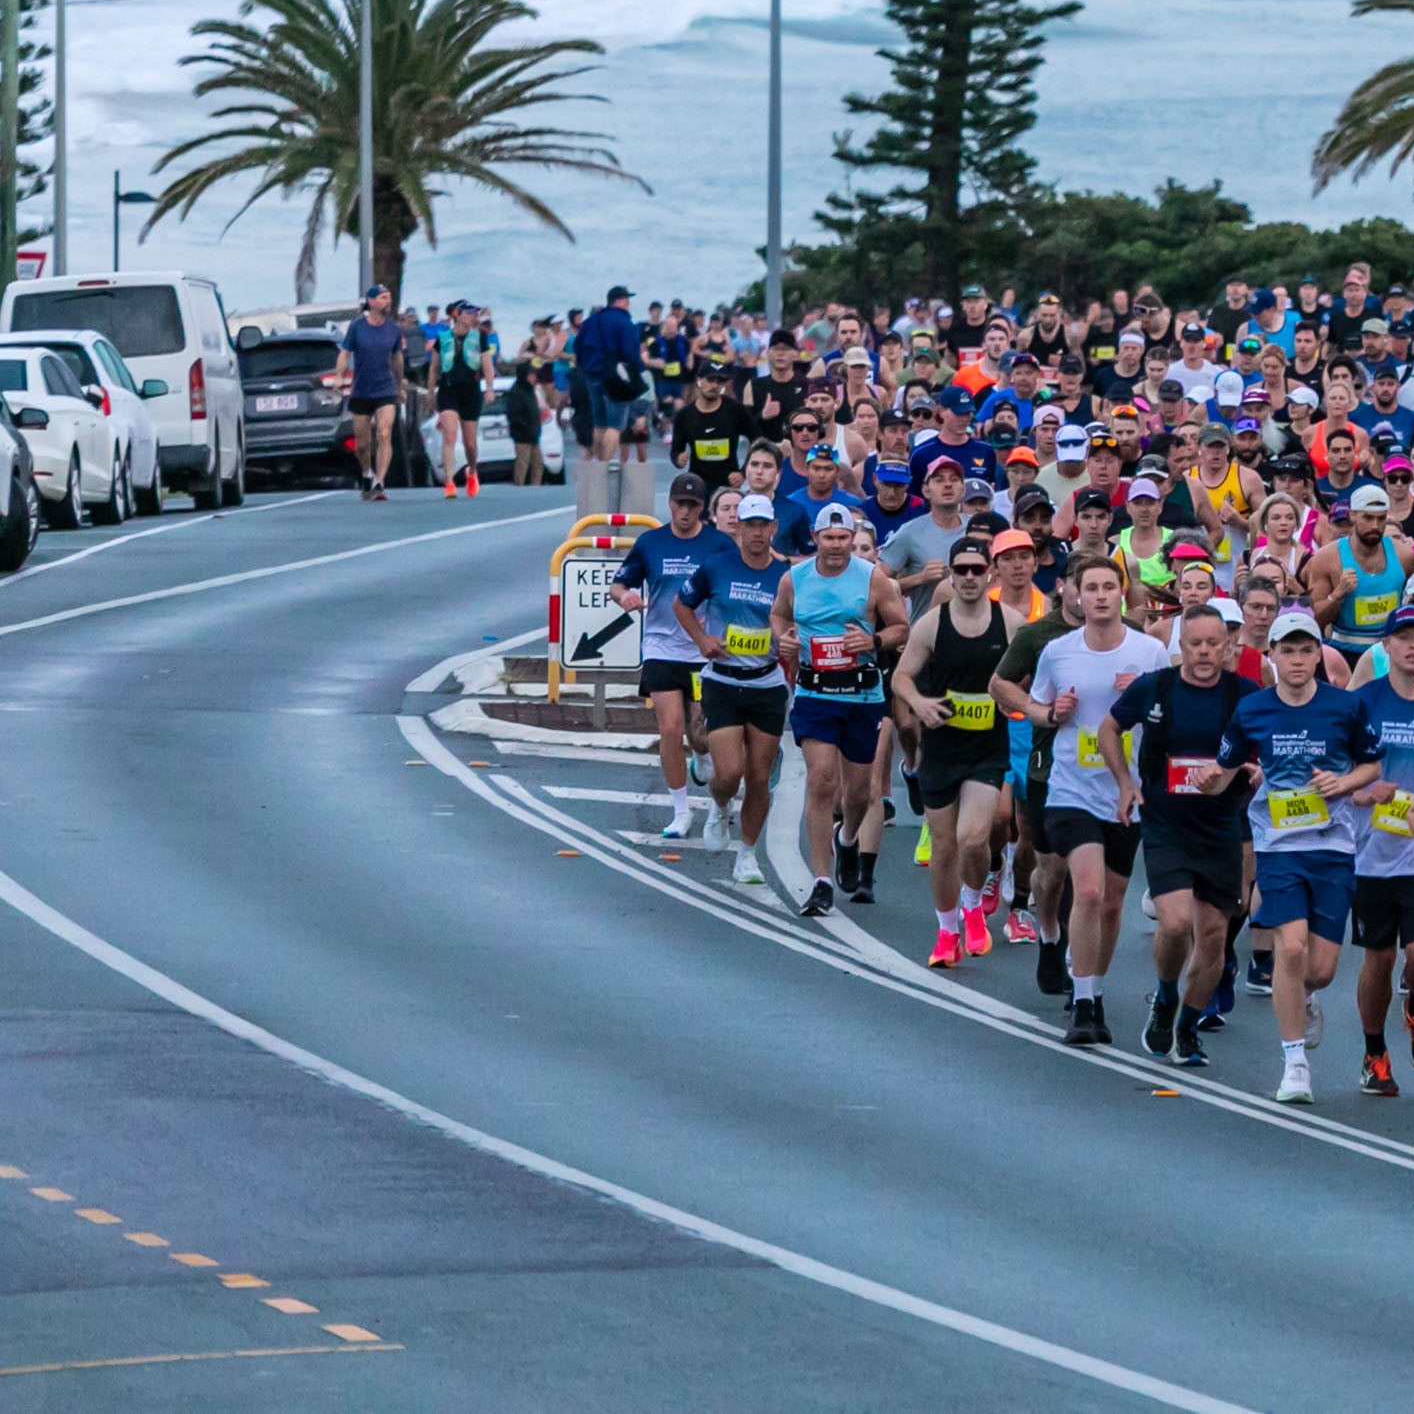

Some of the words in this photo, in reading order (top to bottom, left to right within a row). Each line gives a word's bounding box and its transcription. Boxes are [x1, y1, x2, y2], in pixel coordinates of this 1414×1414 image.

[577, 570, 615, 585] KEE
[579, 592, 612, 608] LEF
[728, 591, 775, 606] MARATHON
[729, 634, 766, 651] 64401
[1272, 746, 1327, 756] MARATHON
